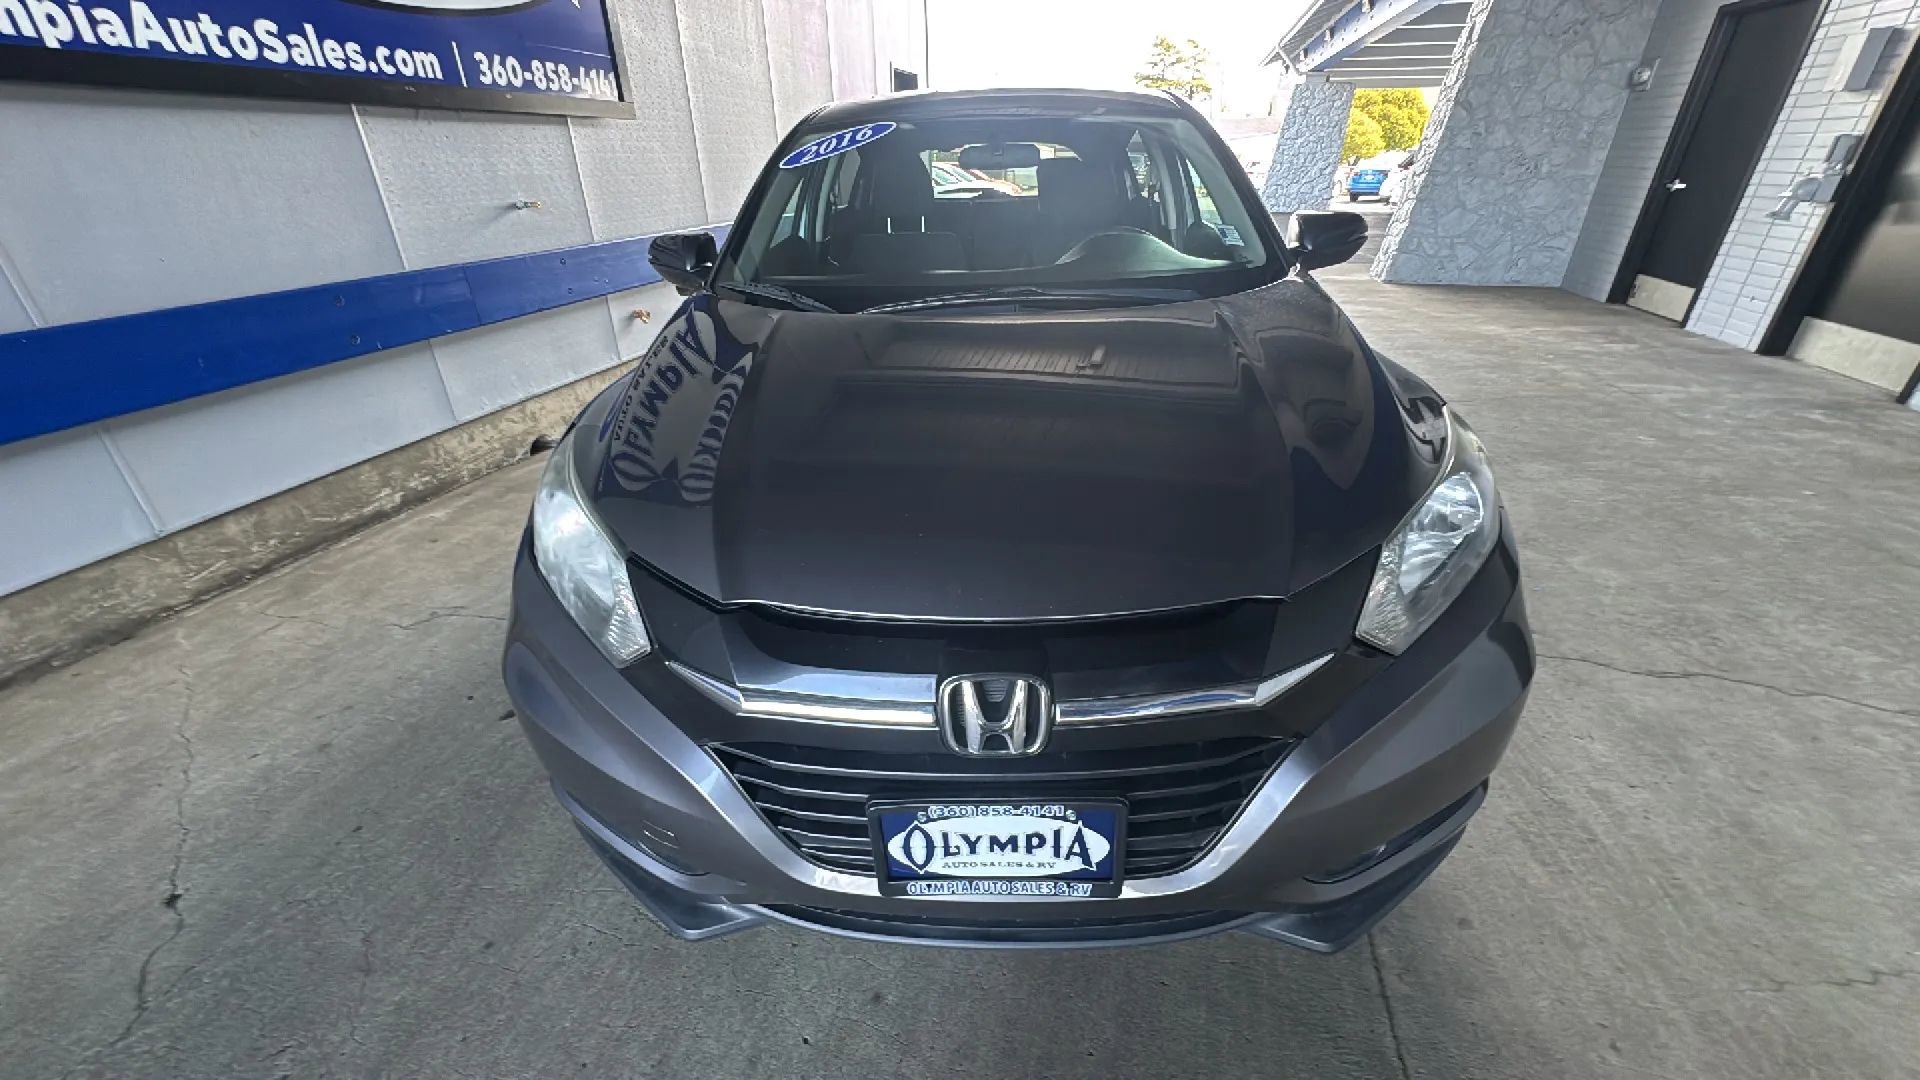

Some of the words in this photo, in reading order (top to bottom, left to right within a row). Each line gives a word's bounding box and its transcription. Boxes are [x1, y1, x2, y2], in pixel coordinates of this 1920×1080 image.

[800, 125, 873, 163] 2016
[902, 820, 1097, 874] OLYMPIA
[907, 881, 971, 895] OLYMPIA
[972, 881, 1011, 895] AUTO
[1011, 881, 1055, 895] SALES
[1056, 882, 1068, 896] &
[1069, 883, 1092, 896] RV
